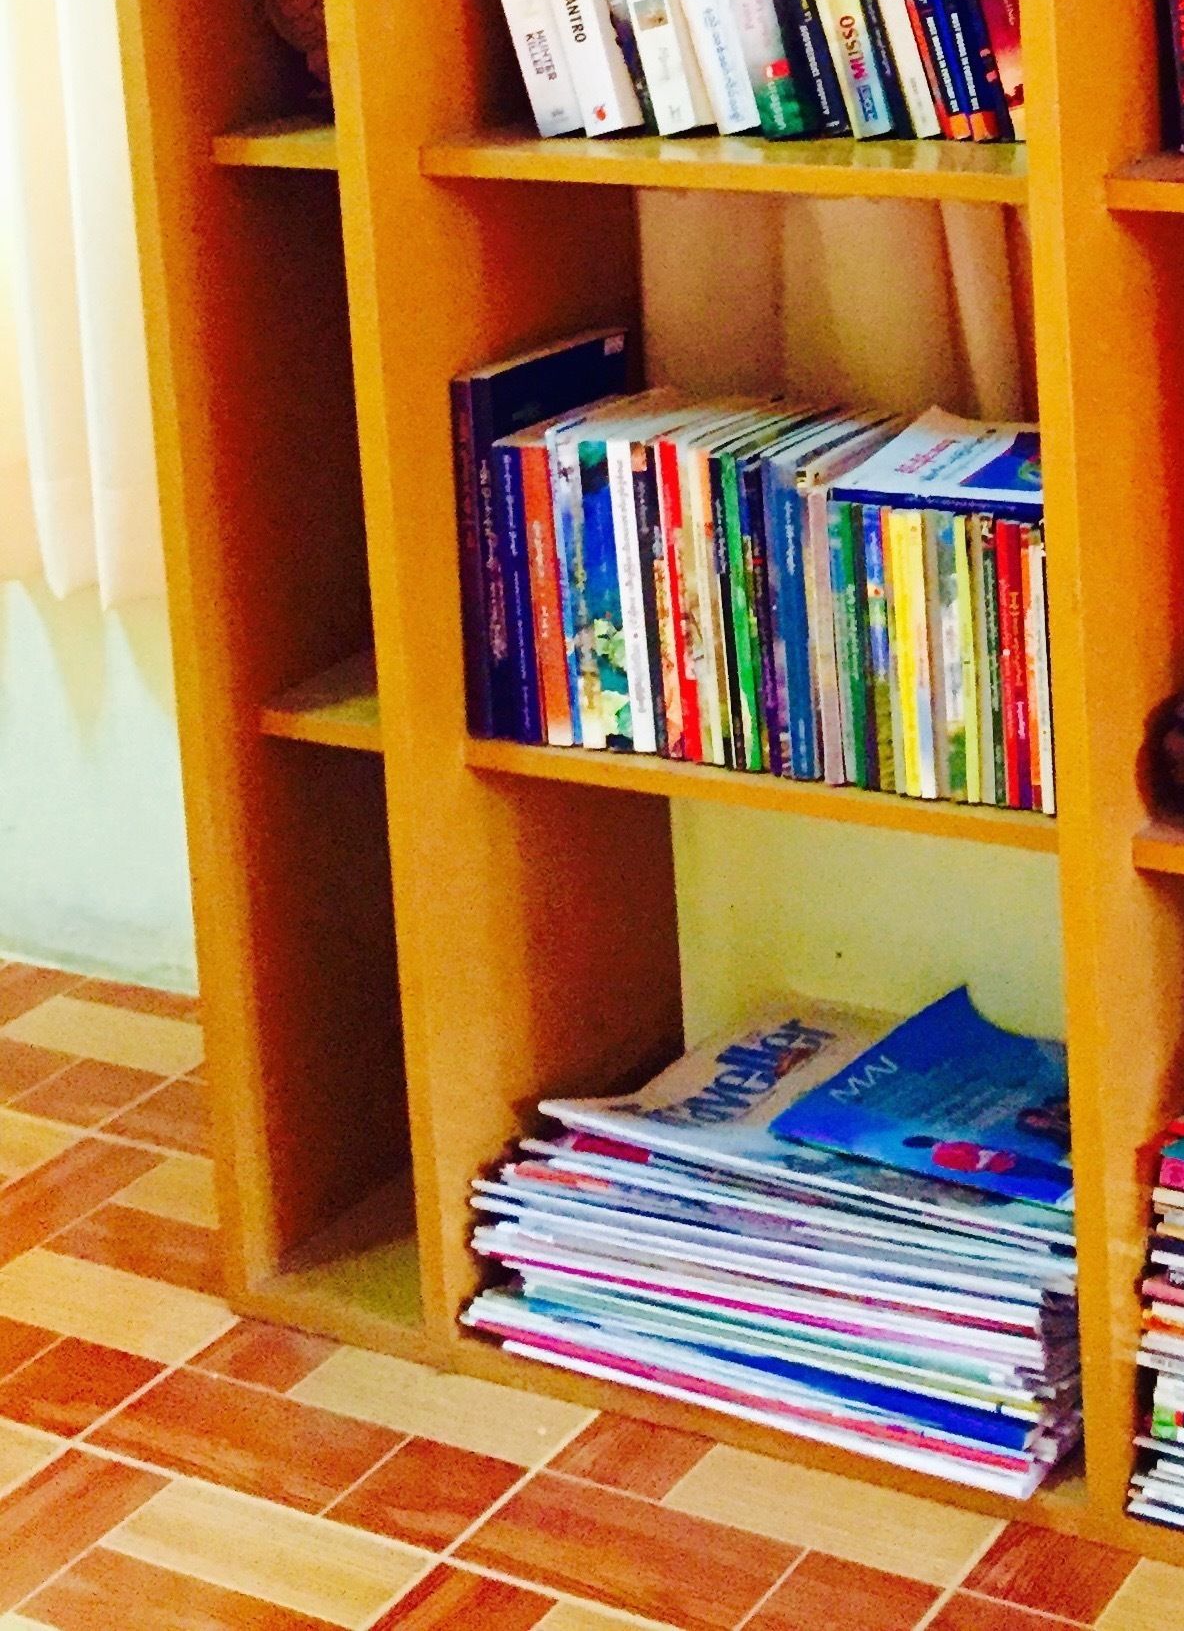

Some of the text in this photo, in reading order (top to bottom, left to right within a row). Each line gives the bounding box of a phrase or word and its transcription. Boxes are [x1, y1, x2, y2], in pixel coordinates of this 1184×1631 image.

[522, 31, 547, 76] KILLER
[531, 28, 560, 82] HUNTER
[836, 12, 871, 80] MUSSO
